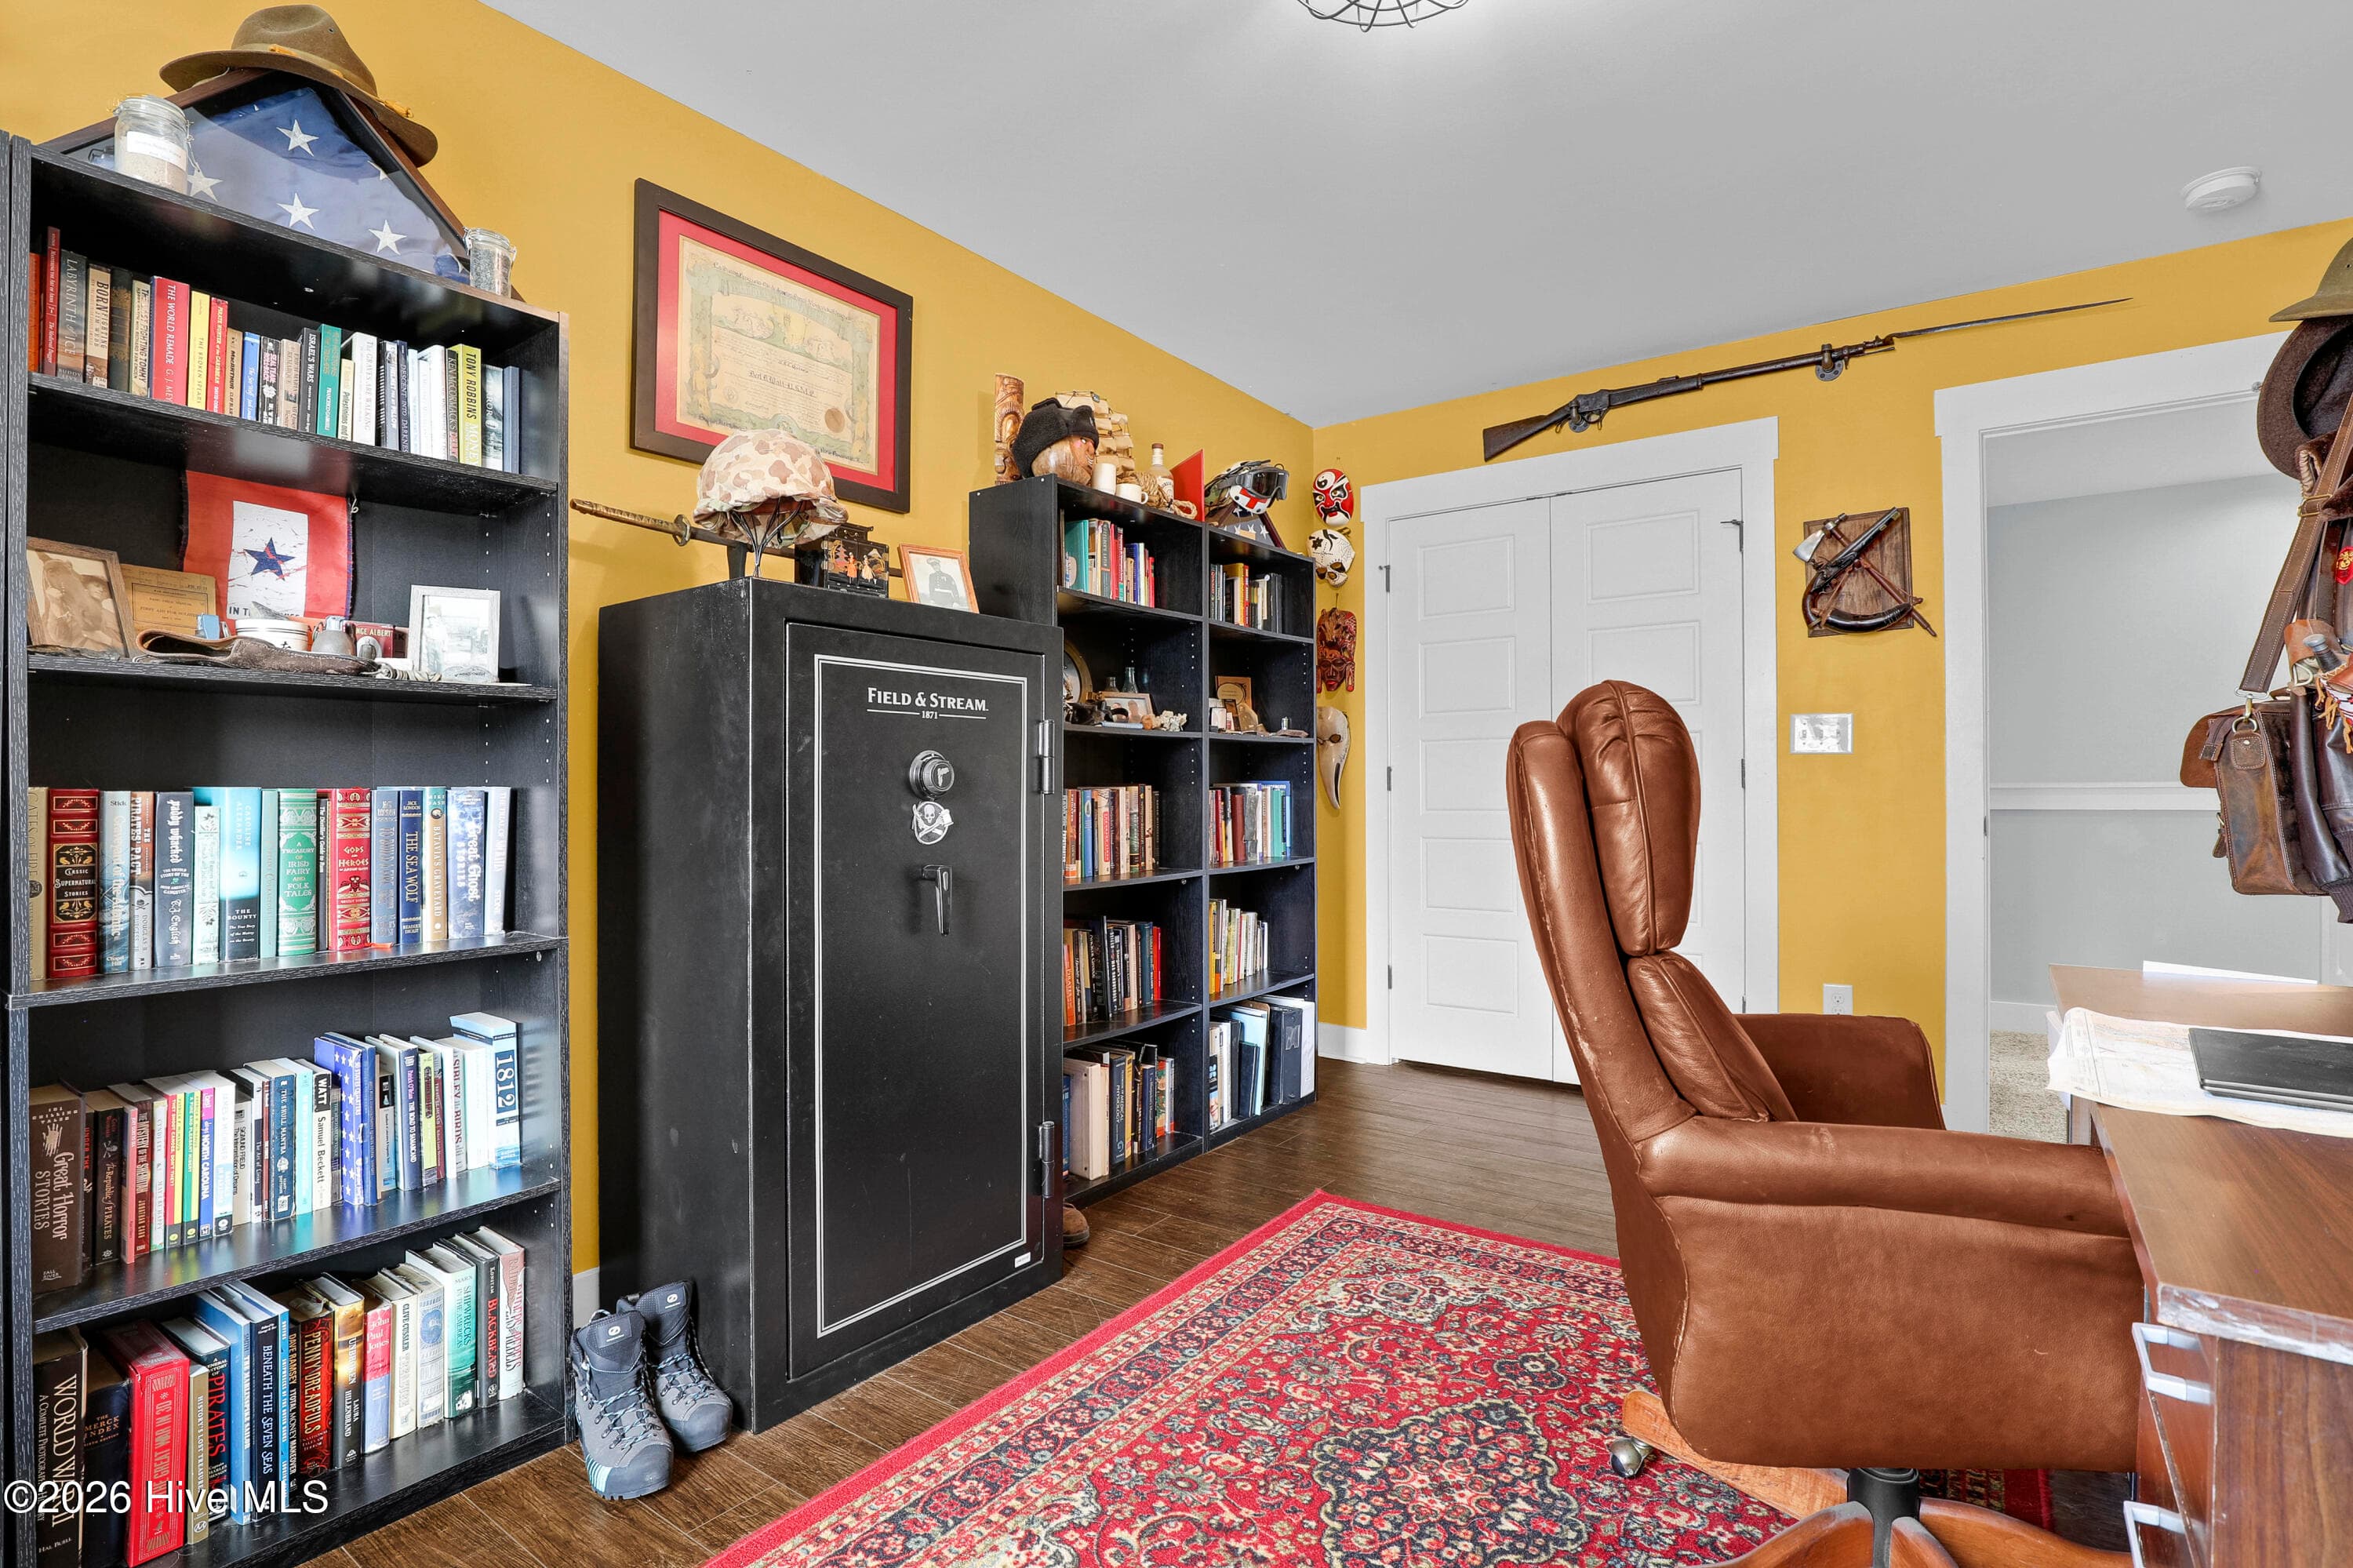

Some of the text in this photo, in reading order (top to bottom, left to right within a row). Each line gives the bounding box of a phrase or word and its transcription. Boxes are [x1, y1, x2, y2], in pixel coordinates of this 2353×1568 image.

[65, 259, 78, 322] LABYRINTH
[96, 281, 108, 311] BORN
[167, 285, 176, 300] THE
[166, 303, 175, 332] WORLD
[64, 336, 76, 355] ICE
[140, 326, 148, 356] FIGHTING
[165, 333, 174, 364] REMADE
[307, 363, 315, 383] WARS
[466, 353, 479, 466] TONY ROBBINS MONEY
[369, 628, 392, 637] ALBERT
[867, 687, 987, 711] FIELD & STREAM
[922, 711, 938, 719] 1871
[130, 796, 141, 875] PIRATES' PACT
[166, 799, 184, 864] paddy whacked
[467, 826, 482, 861] Great
[111, 816, 125, 937] Graveyard of the Atlantic
[339, 859, 369, 868] HEROES
[405, 831, 418, 903] THE SEA WOLF
[456, 842, 465, 887] STORIES
[54, 879, 96, 889] SUPERNATURAL
[467, 864, 482, 901] Ghost
[169, 915, 182, 944] English
[496, 1054, 515, 1108] 1812
[138, 1112, 148, 1121] THE
[316, 1078, 328, 1184] WATT Samuel Beckett
[136, 1121, 149, 1148] MYSTERY
[136, 1163, 149, 1194] SHEMITAH
[201, 1134, 210, 1200] NORTH CAROLINA
[34, 1170, 50, 1230] STORIES
[51, 1151, 75, 1240] Great Horror
[104, 1171, 115, 1199] Republic
[104, 1206, 113, 1239] PIRATES
[137, 1200, 146, 1224] JONATHAN
[137, 1225, 146, 1239] CAHN
[369, 1318, 389, 1330] John
[464, 1286, 472, 1346] SHIPWRECKS
[367, 1329, 383, 1341] Paul
[367, 1339, 389, 1353] Jones
[488, 1298, 498, 1378] BLACKBEARD
[347, 1337, 357, 1384] UNBROKEN
[304, 1333, 322, 1435] PENNY DREADFULS
[53, 1374, 77, 1457] WORLD
[156, 1400, 173, 1414] 3D
[156, 1414, 172, 1427] IN
[208, 1373, 226, 1457] PIRATES
[261, 1345, 273, 1475] BENEATH THE SEVEN SEAS
[344, 1390, 353, 1437] HILLENBRAND
[84, 1415, 120, 1432] MERCK
[85, 1423, 120, 1438] INDEX
[155, 1428, 171, 1450] WAR
[153, 1450, 170, 1479] GREAT
